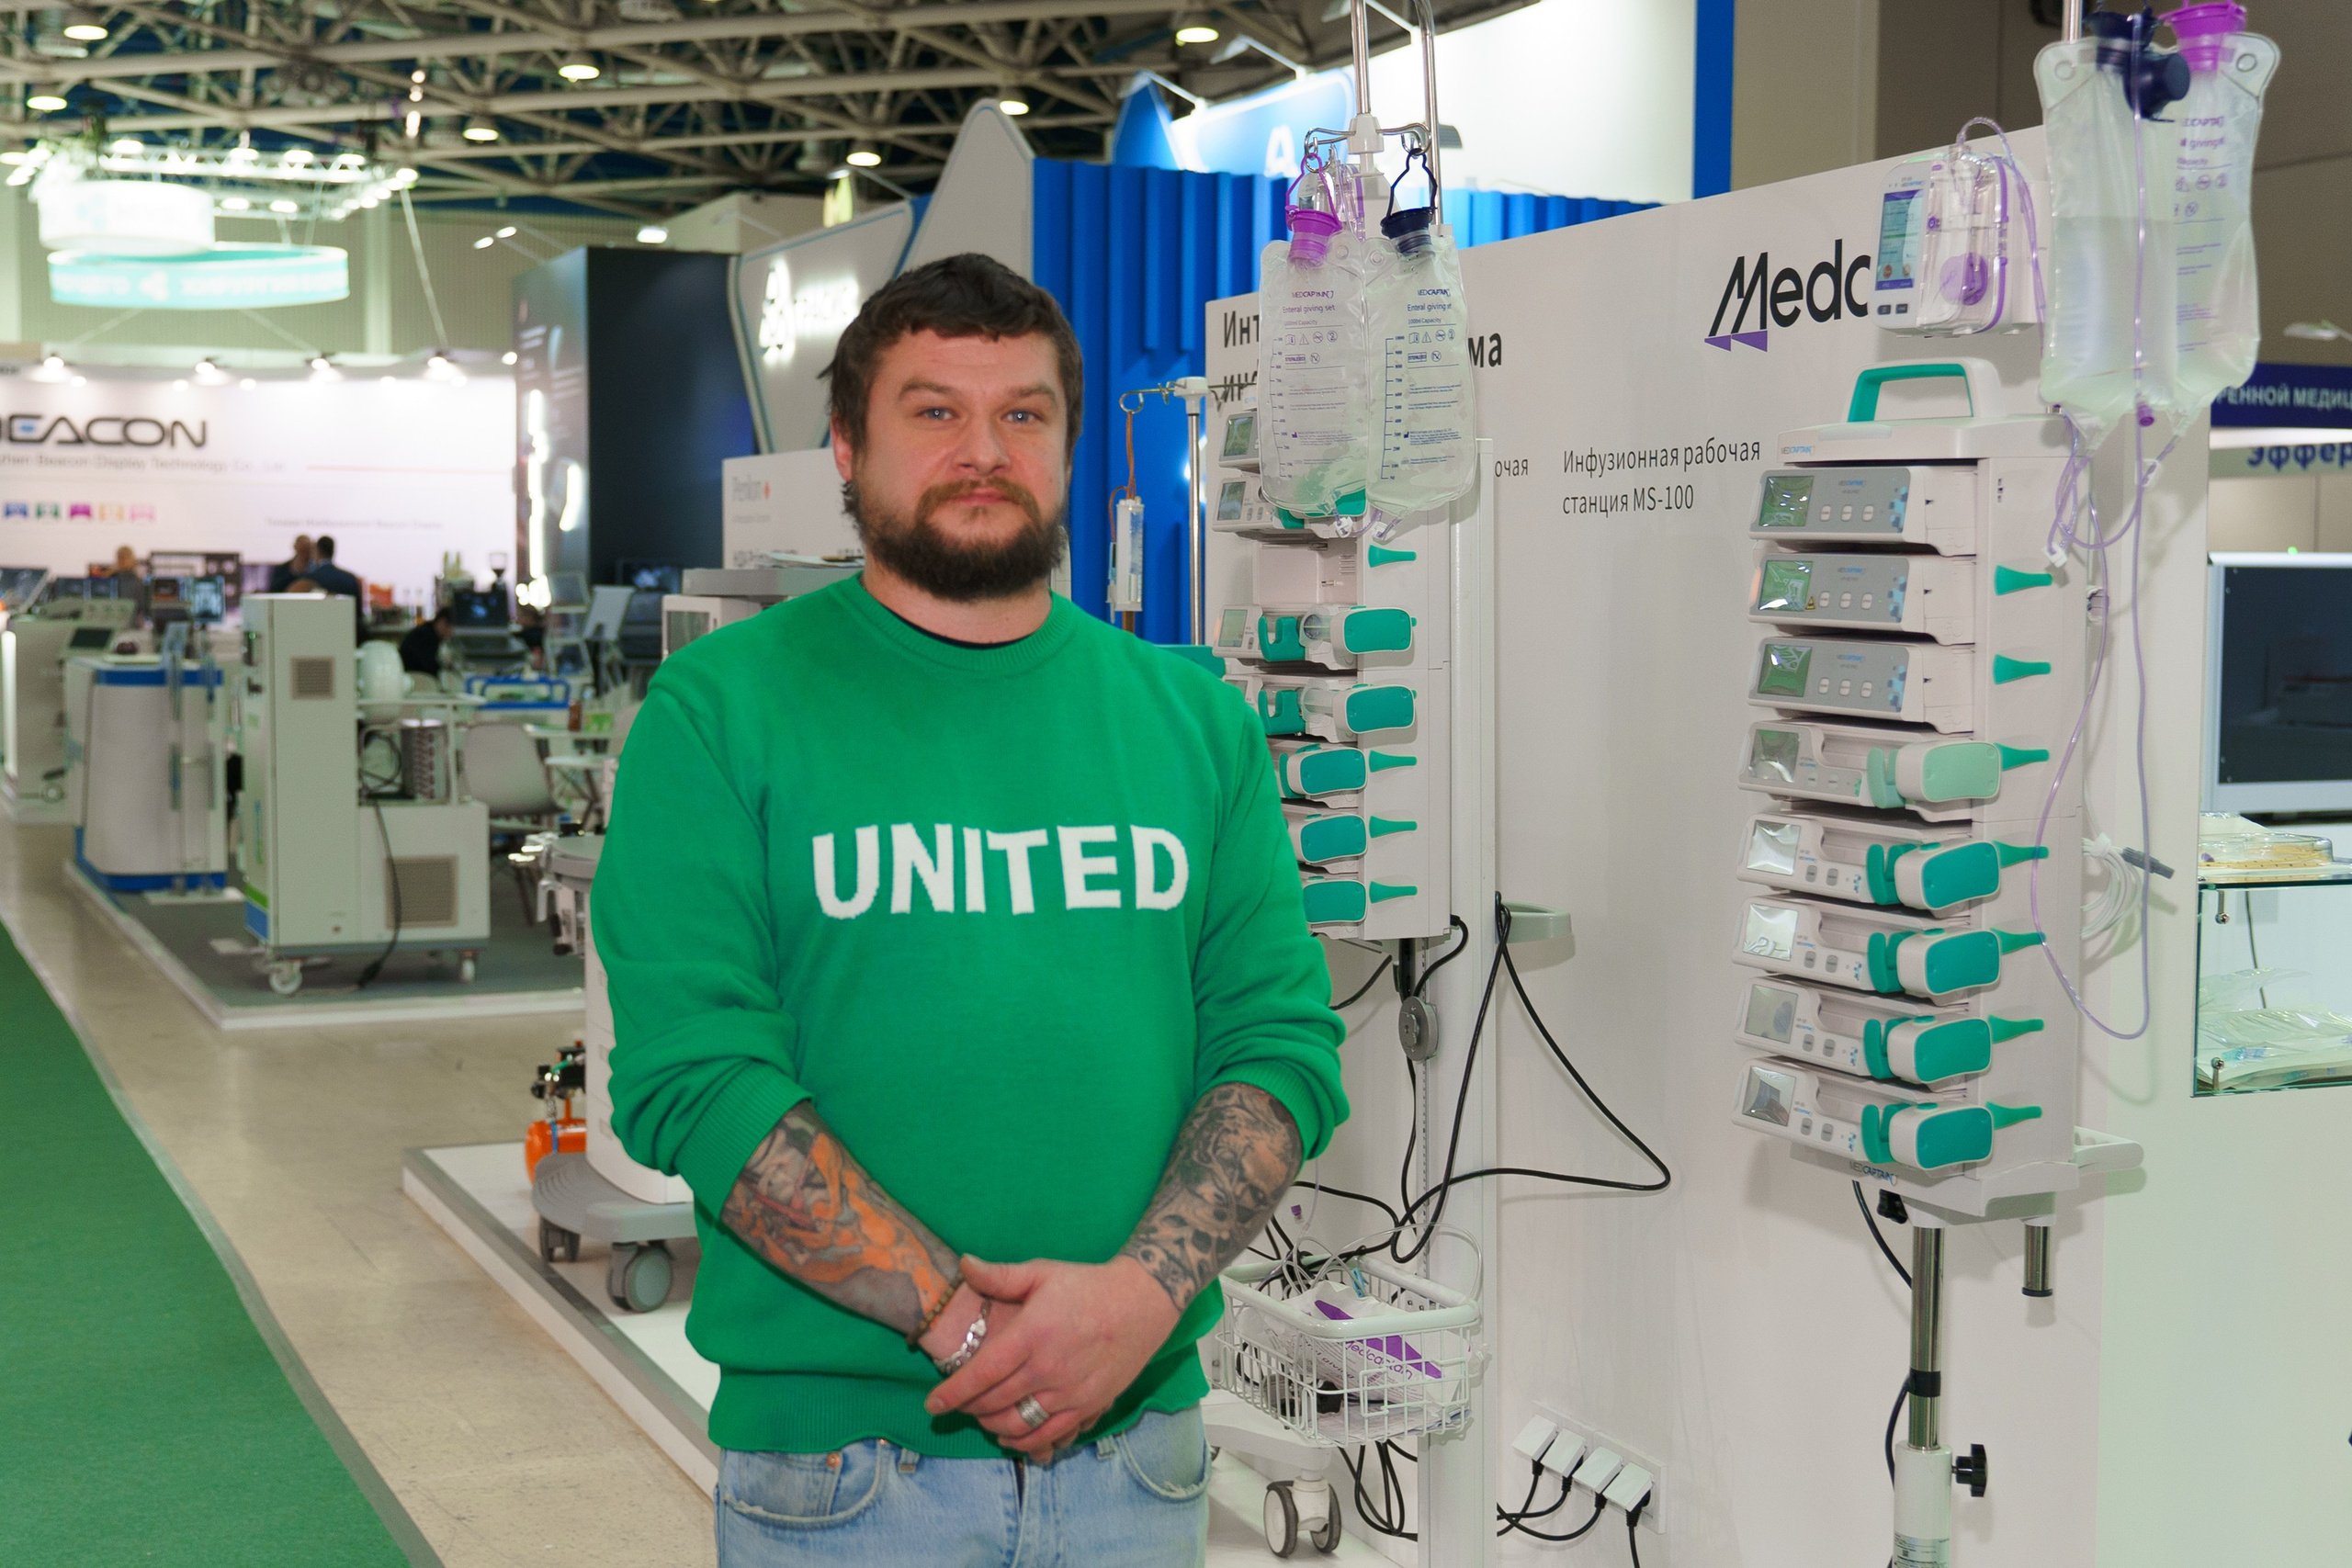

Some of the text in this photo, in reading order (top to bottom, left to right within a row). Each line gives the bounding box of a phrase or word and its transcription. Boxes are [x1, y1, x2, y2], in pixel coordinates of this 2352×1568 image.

[1303, 305, 1323, 314] giving
[1427, 303, 1445, 312] giving
[0, 413, 208, 448] EACON
[1564, 436, 1760, 479] Инфузионная рабочая
[1563, 484, 1694, 518] станция MS-100
[812, 823, 1189, 919] UNITED
